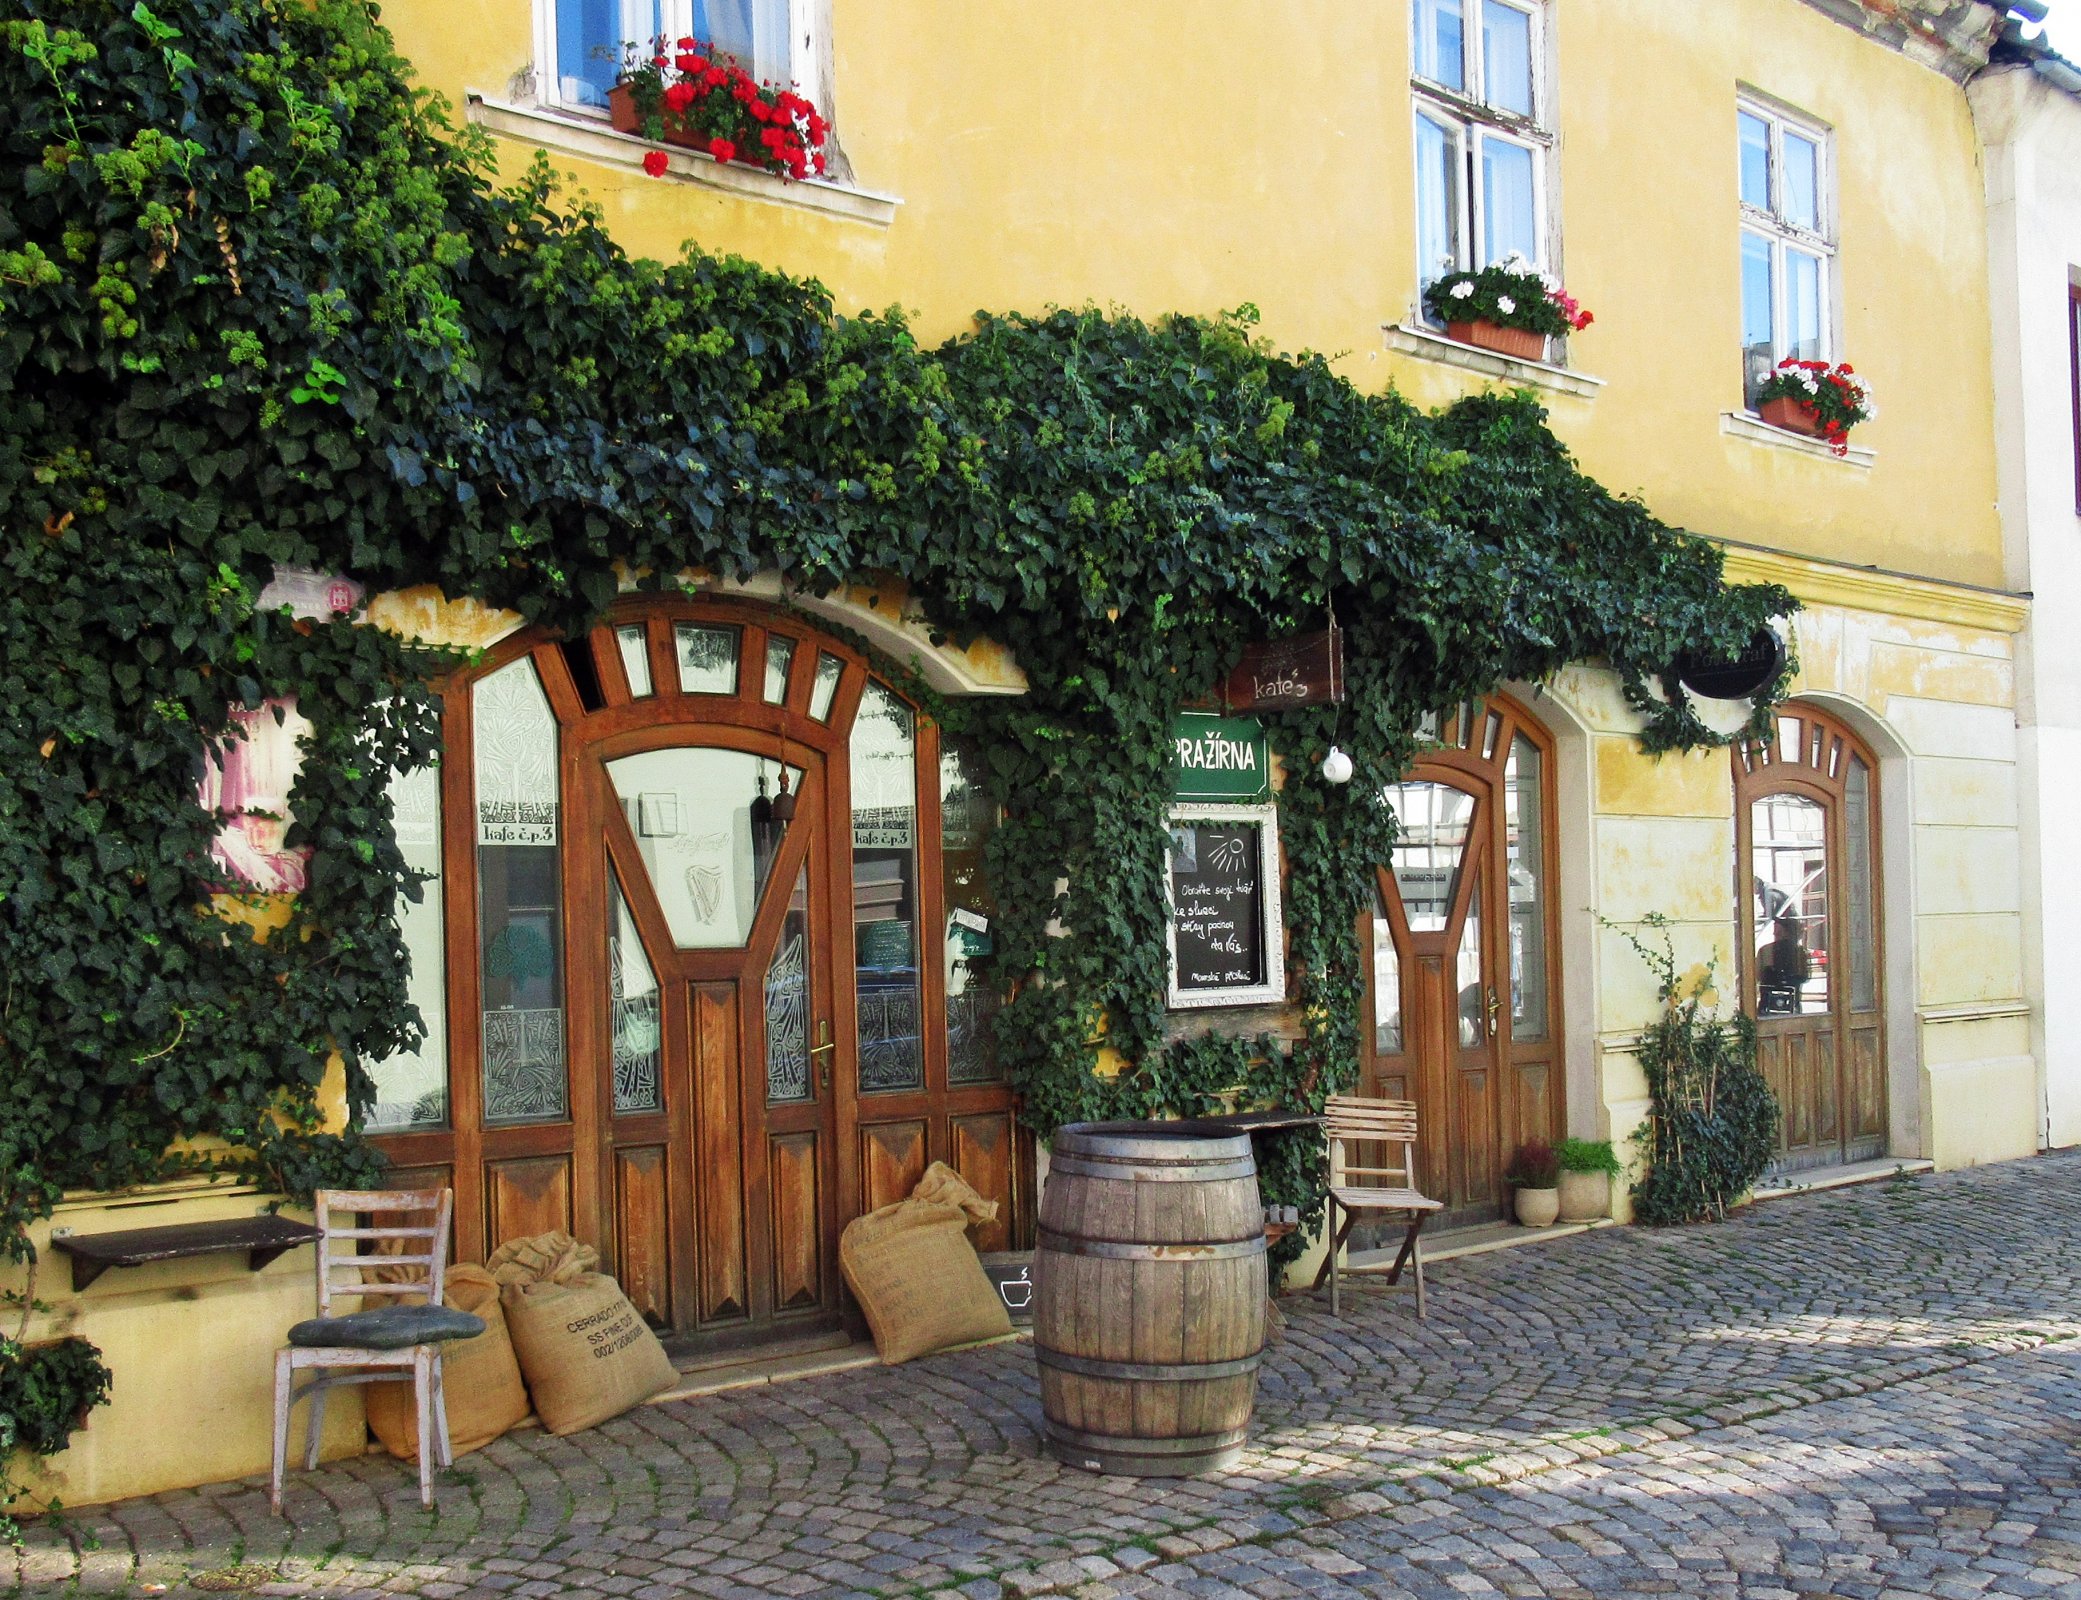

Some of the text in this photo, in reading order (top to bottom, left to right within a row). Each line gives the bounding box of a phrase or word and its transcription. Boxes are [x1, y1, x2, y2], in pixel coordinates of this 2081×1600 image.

[483, 825, 515, 843] kafe
[855, 831, 879, 846] kafe
[567, 1308, 614, 1333] CERRADO
[587, 1332, 605, 1345] SS
